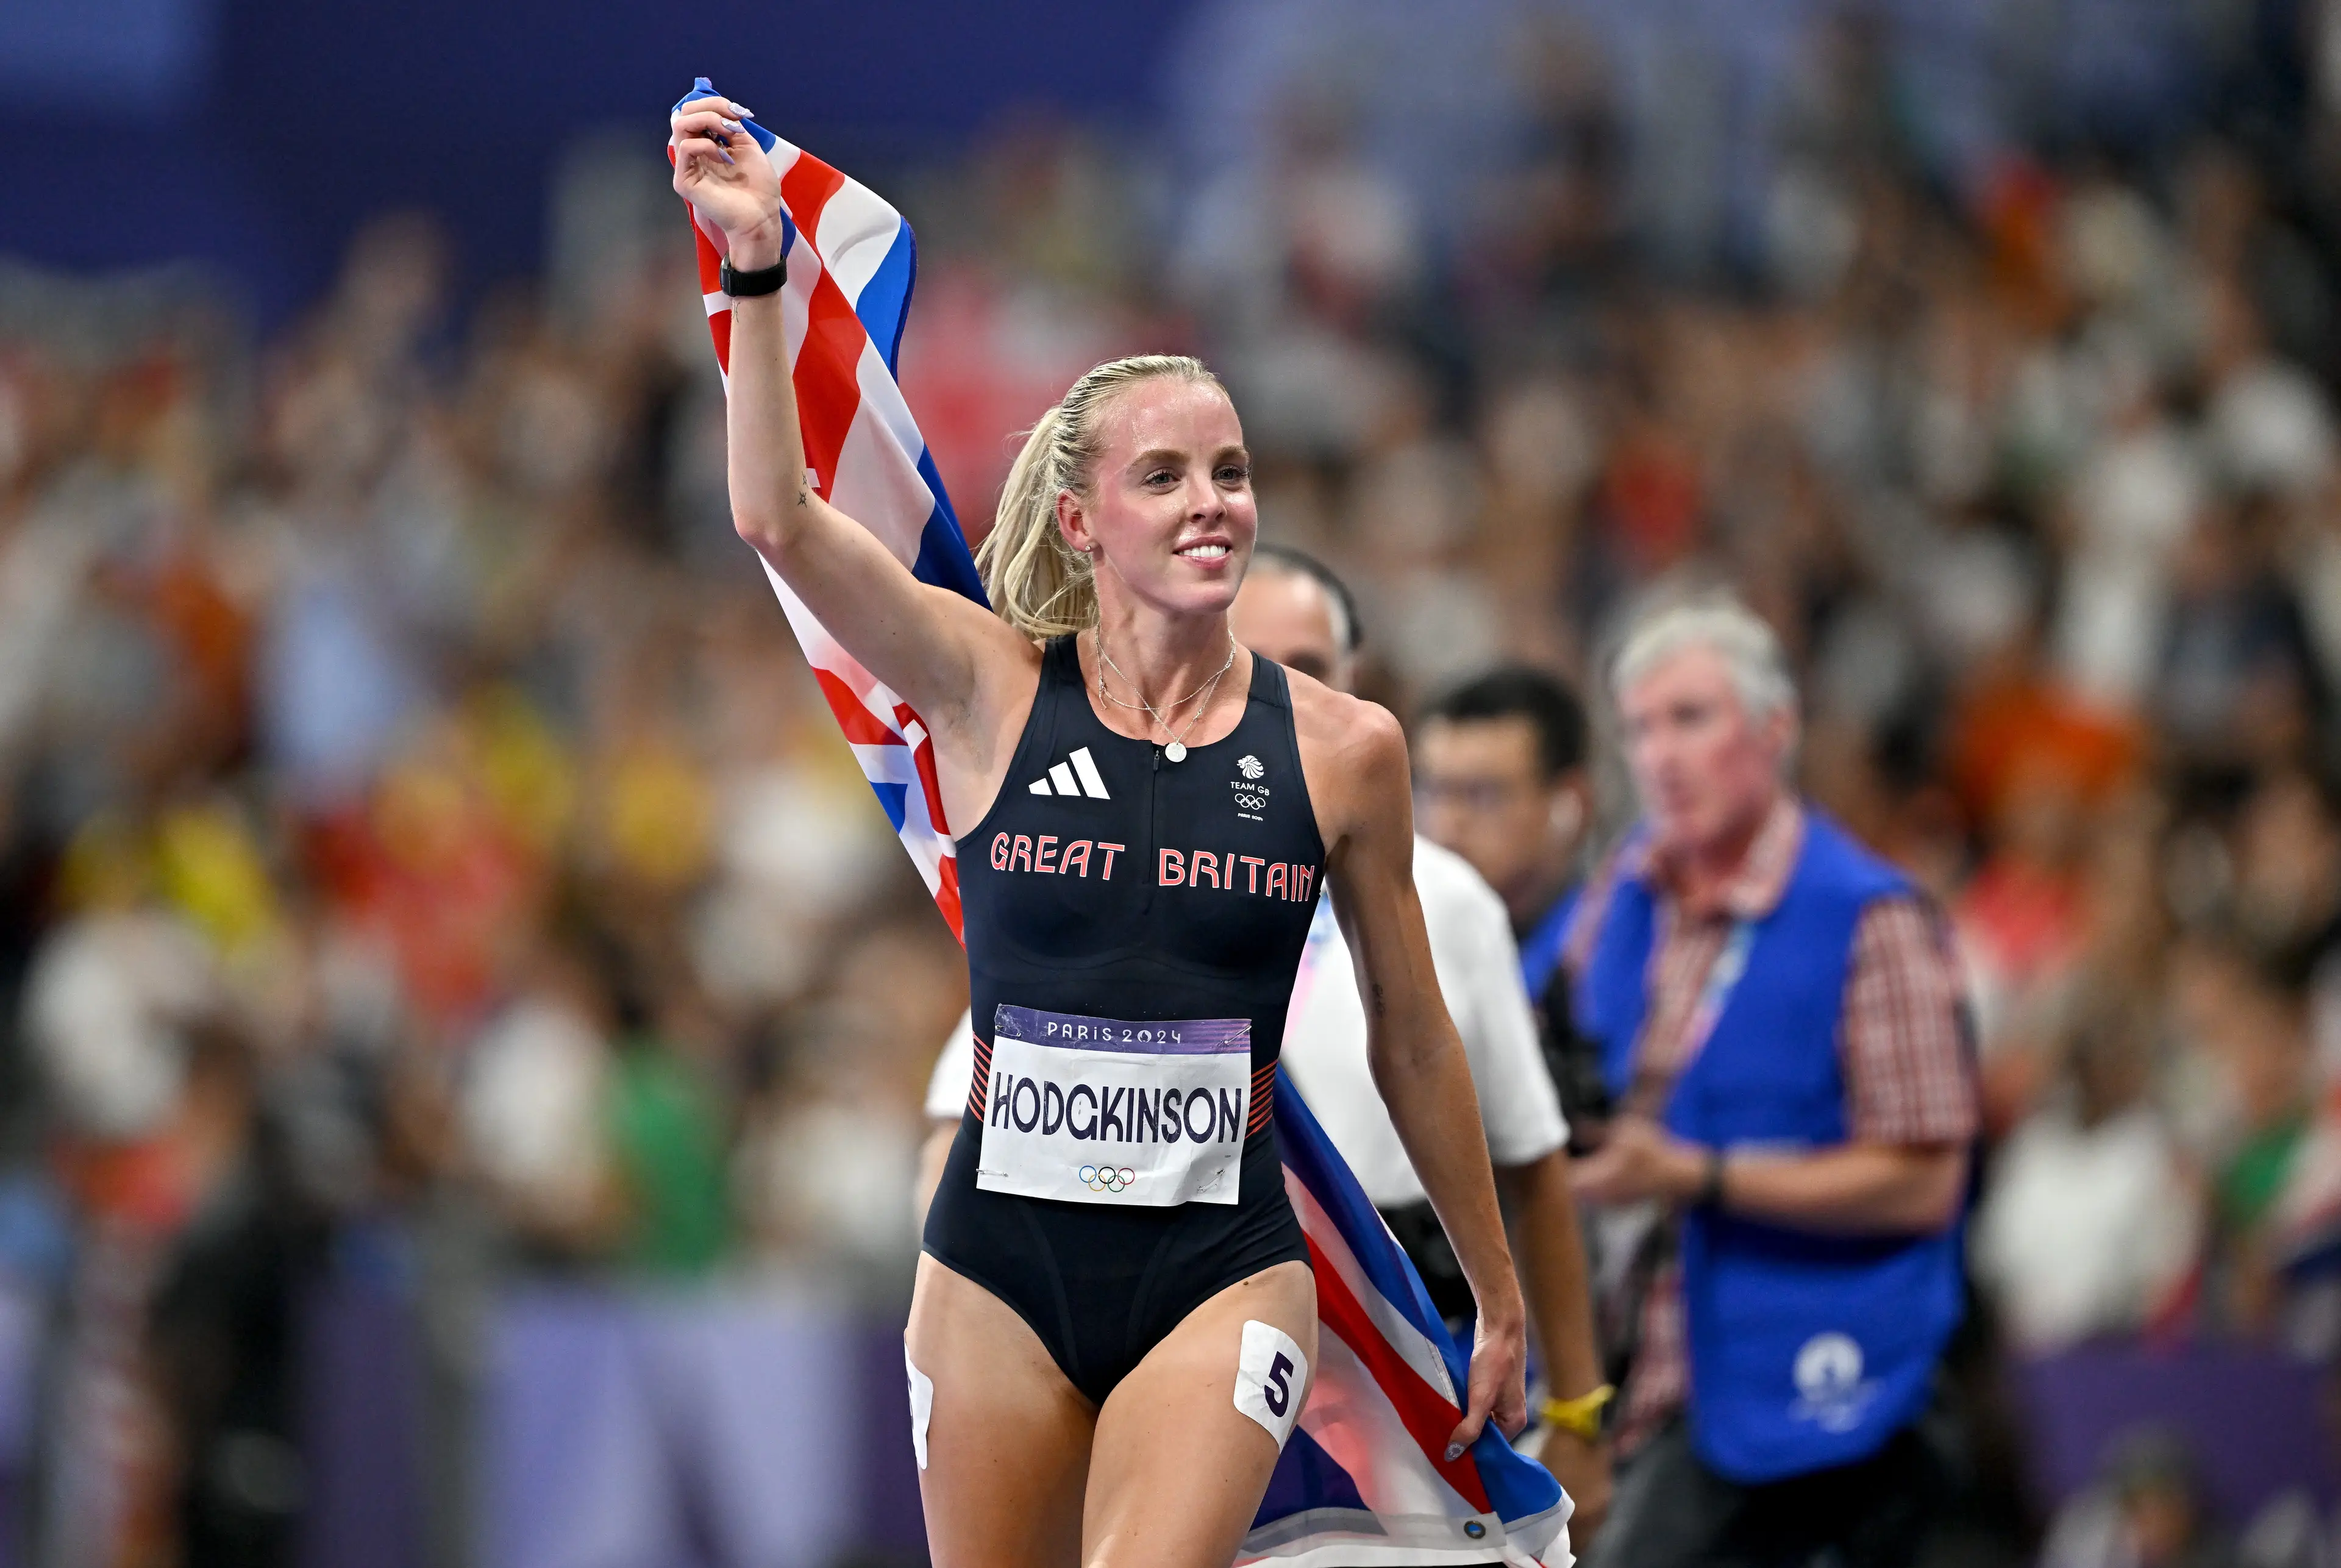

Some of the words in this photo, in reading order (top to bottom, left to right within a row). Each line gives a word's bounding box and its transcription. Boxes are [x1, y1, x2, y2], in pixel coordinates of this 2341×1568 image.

[1230, 782, 1255, 791] TEAM
[1257, 786, 1270, 796] GB
[990, 832, 1125, 880] GREAT
[1159, 848, 1315, 902] BRITAIN
[1122, 1028, 1181, 1044] 2024
[991, 1072, 1242, 1144] HODGKINSON
[1264, 1351, 1294, 1417] 5
